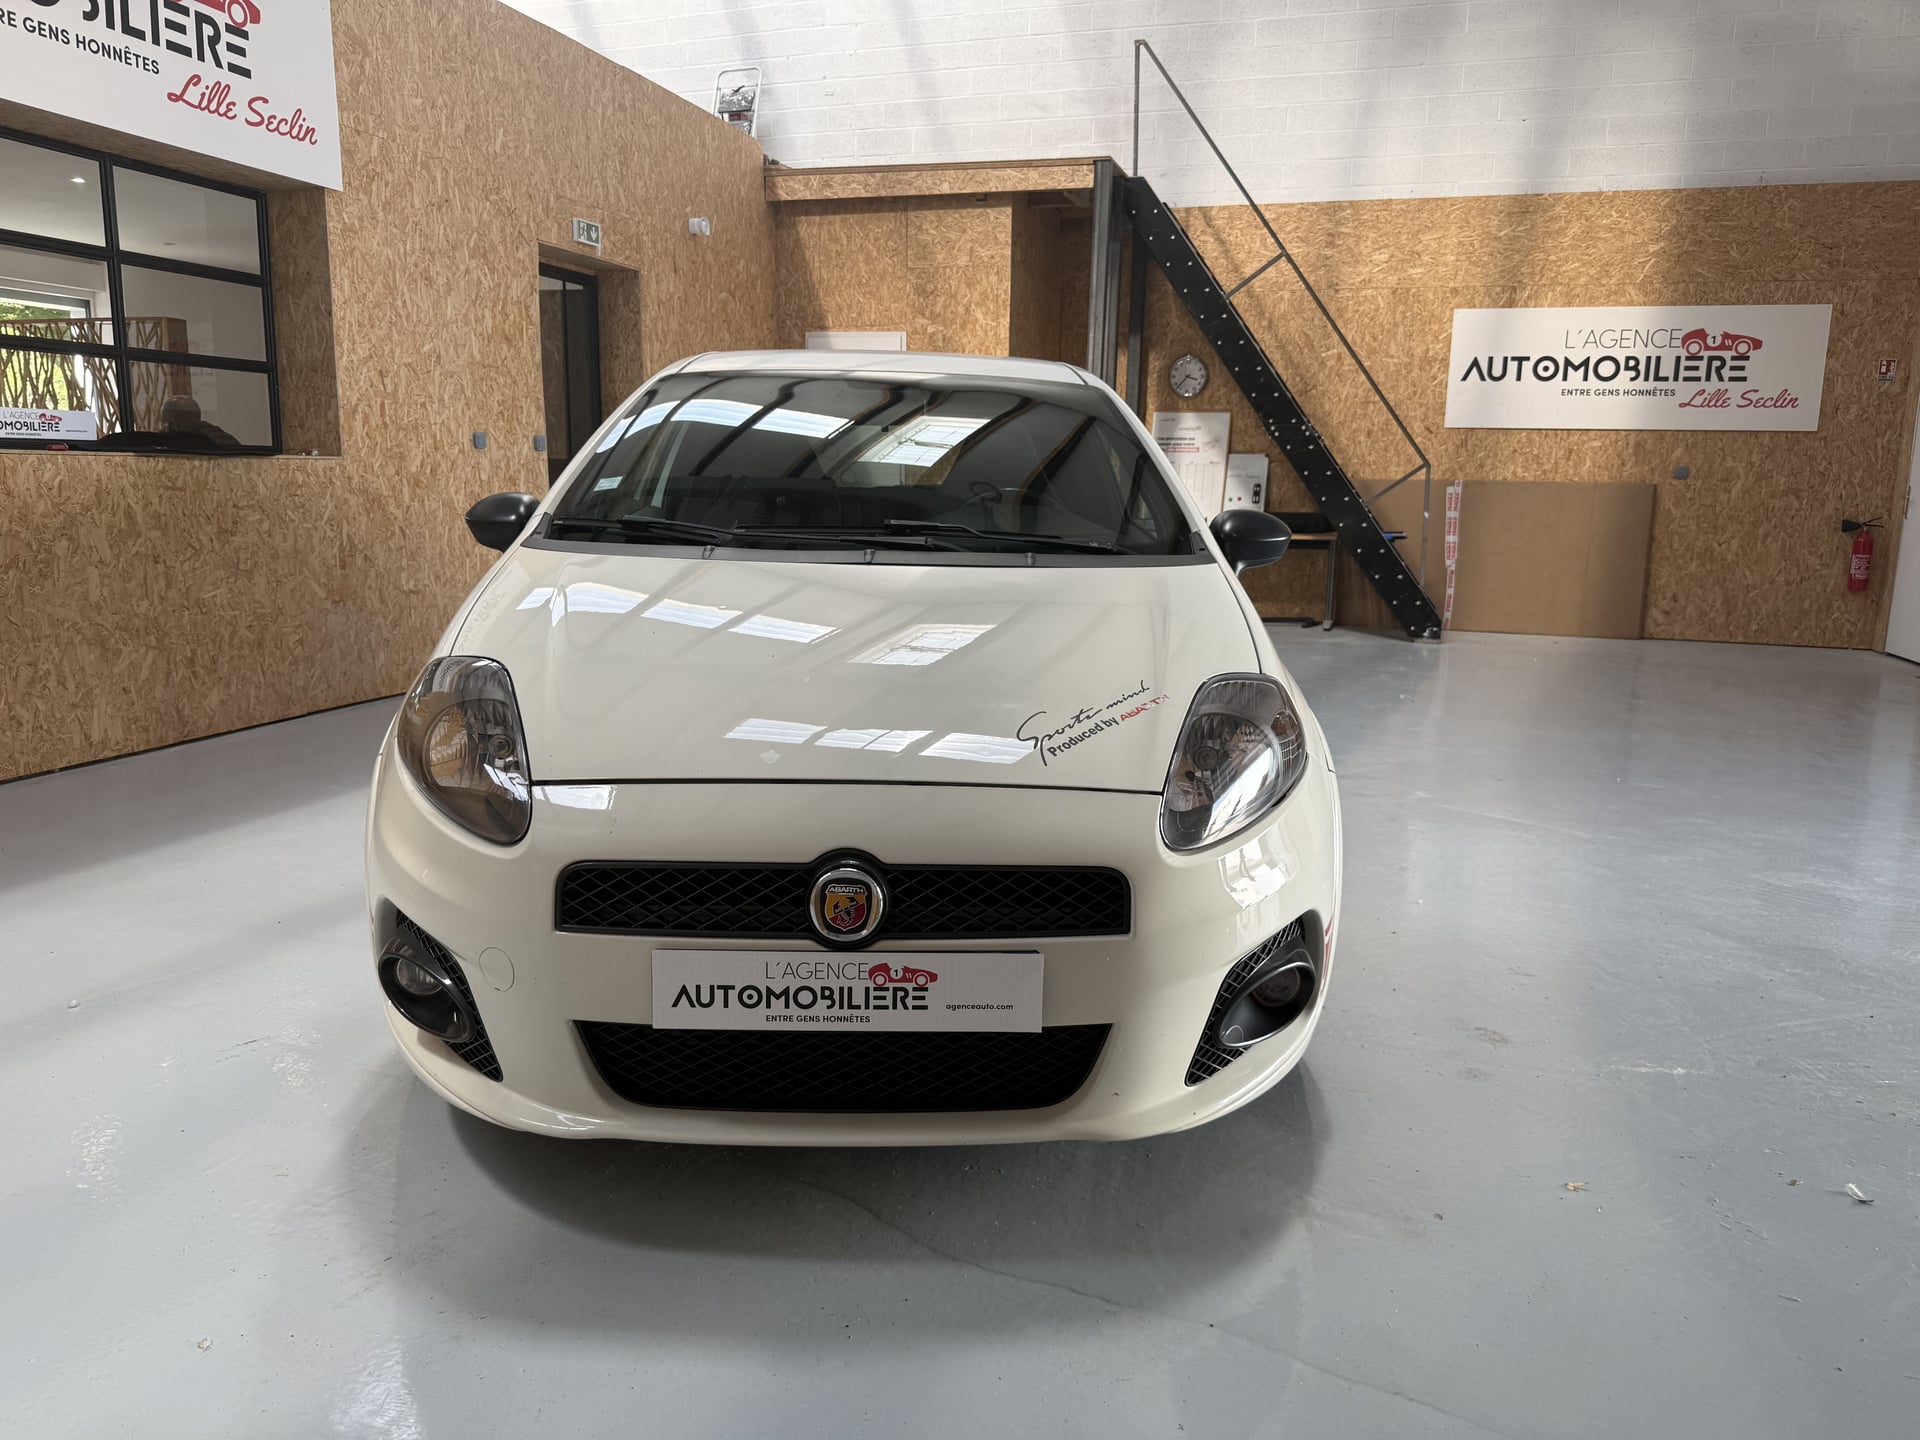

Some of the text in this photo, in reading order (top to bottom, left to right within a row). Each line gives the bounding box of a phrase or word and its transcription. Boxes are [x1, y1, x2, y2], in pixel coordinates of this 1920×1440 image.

[23, 17, 70, 45] GENS
[75, 33, 160, 74] HONNÊTES
[167, 74, 318, 145] Lille Seclin
[1565, 328, 1682, 349] L'AGENCE
[1711, 335, 1717, 345] 1
[1561, 387, 1676, 397] ENTRE GENS HONNÊTES
[1678, 389, 1800, 409] Lille Seclin
[1016, 680, 1150, 767] Sports mind
[1046, 722, 1105, 757] Produced
[1105, 716, 1120, 729] by
[829, 886, 864, 894] ABARTH
[765, 962, 868, 980] L'AGENCE
[893, 969, 898, 977] 1
[945, 1002, 1014, 1012] agenceauto.com
[766, 1013, 871, 1024] ENTRE GENS HONNÊTES
